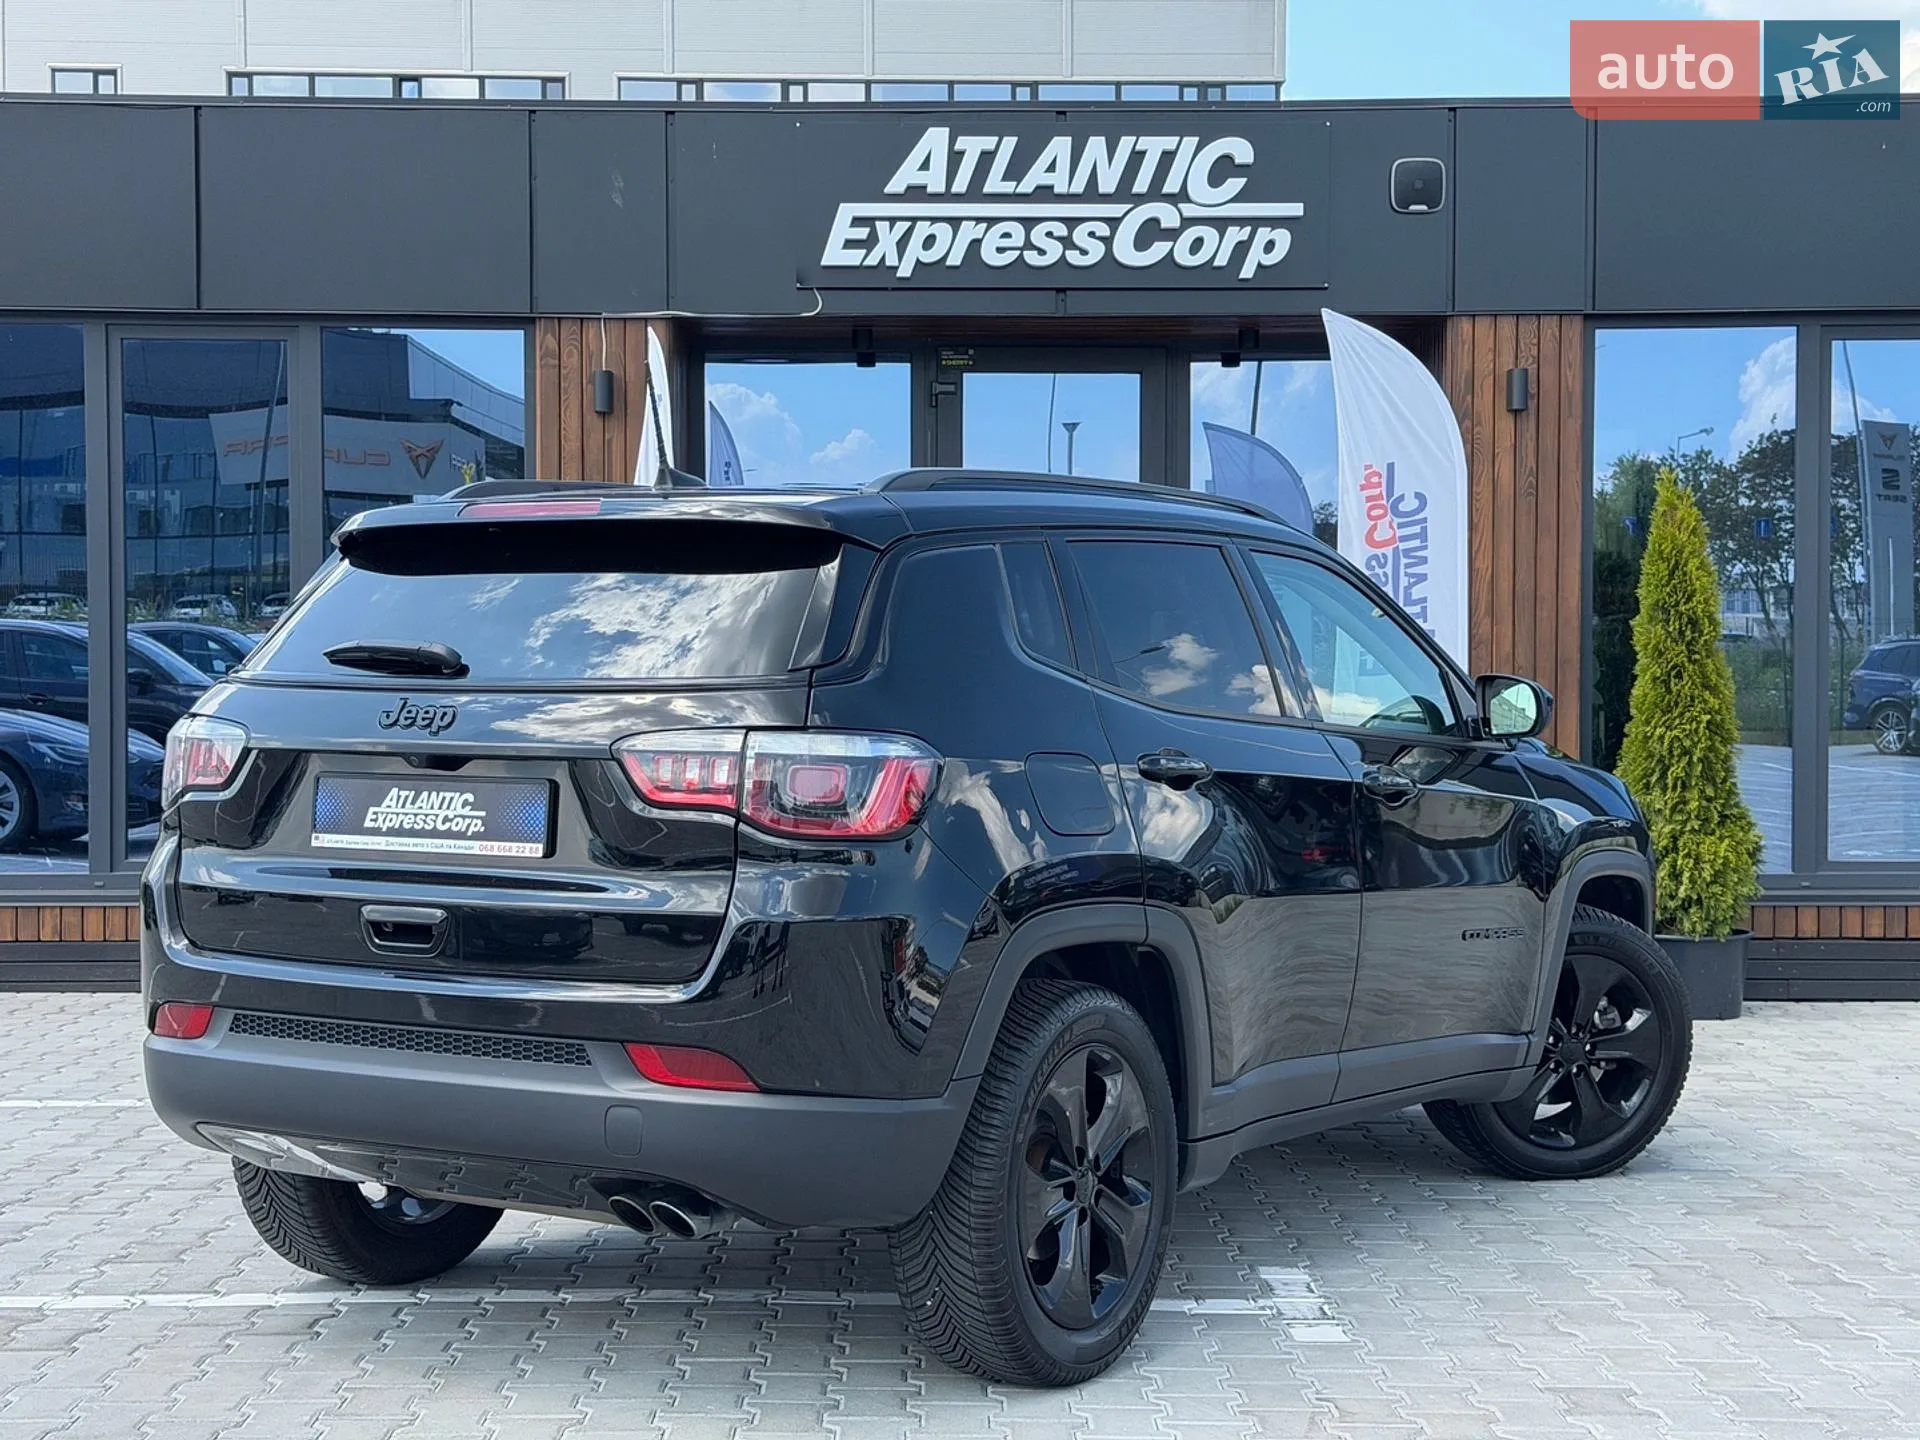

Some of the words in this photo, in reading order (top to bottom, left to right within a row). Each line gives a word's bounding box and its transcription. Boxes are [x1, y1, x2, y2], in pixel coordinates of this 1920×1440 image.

[883, 126, 1255, 206] ATLANTIC
[820, 203, 1292, 280] ExpressCorp
[378, 697, 459, 737] Jeep
[380, 787, 475, 814] ATLANTIC
[363, 807, 486, 836] ExpressCorp.
